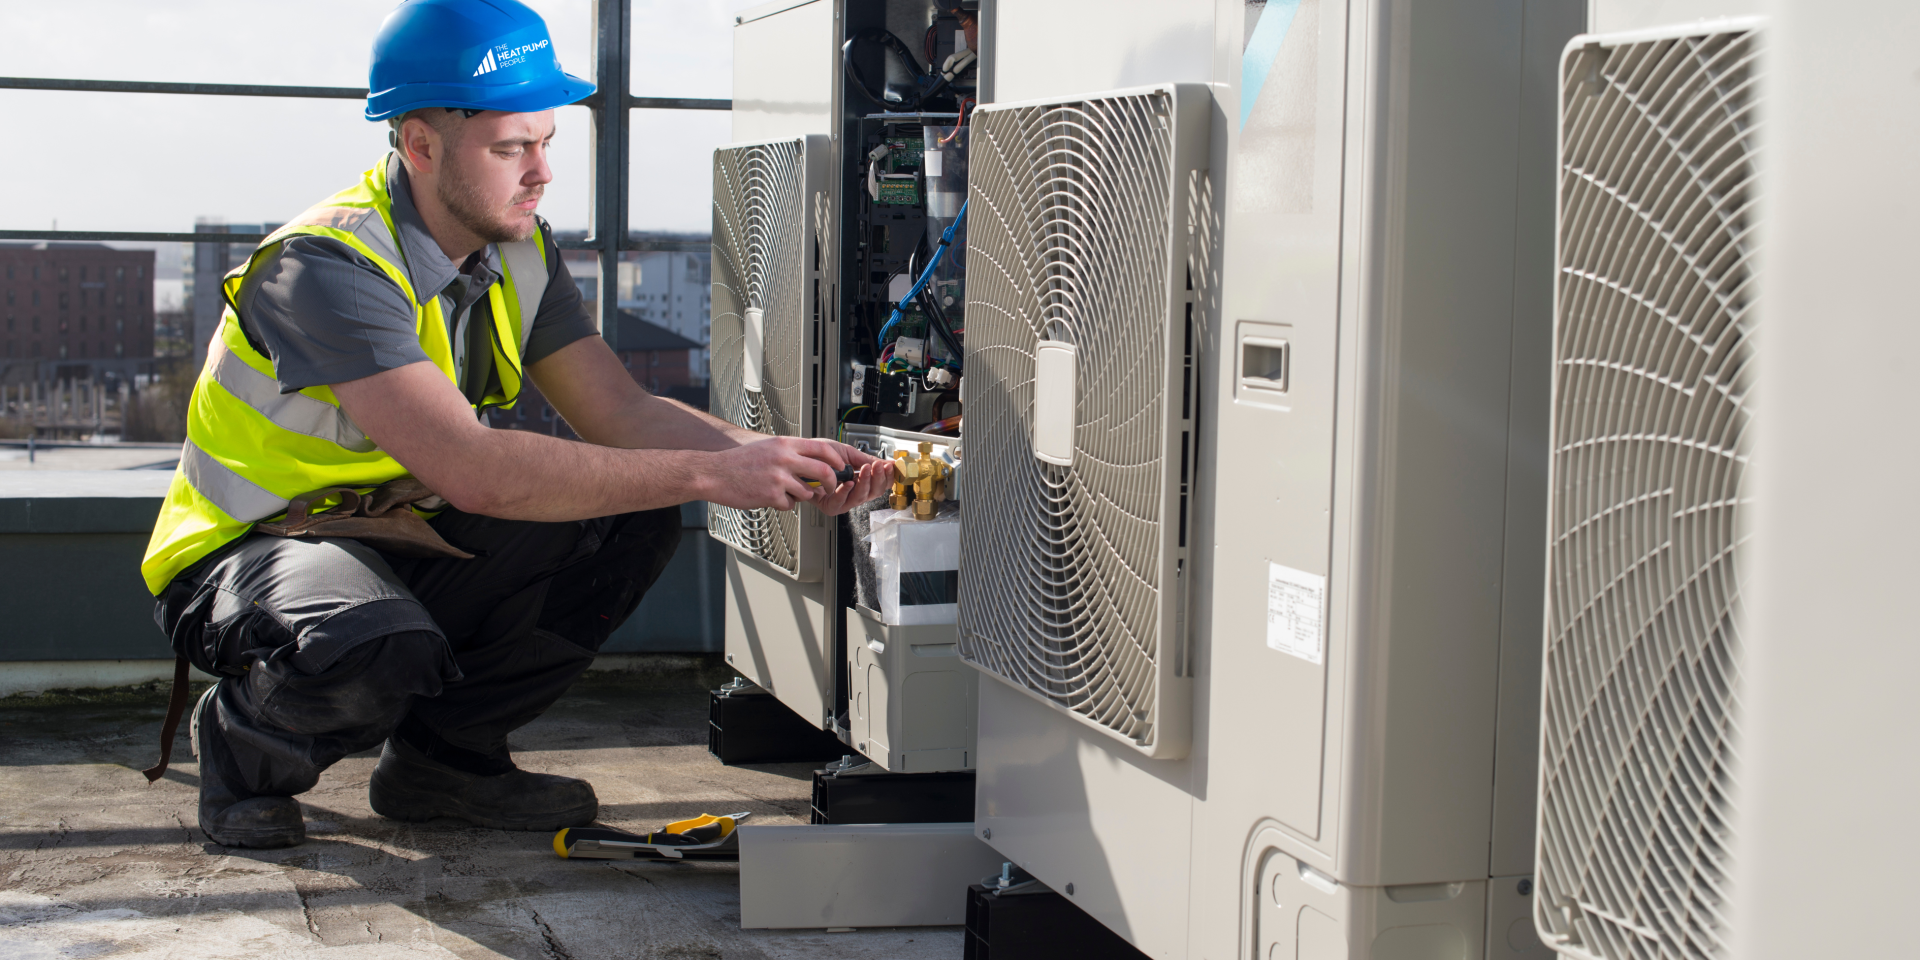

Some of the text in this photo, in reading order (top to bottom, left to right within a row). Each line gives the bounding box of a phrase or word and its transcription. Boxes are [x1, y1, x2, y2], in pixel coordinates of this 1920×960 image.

[494, 43, 508, 52] THE
[497, 39, 549, 61] HEAT PUMP
[499, 56, 526, 69] PEOPLE
